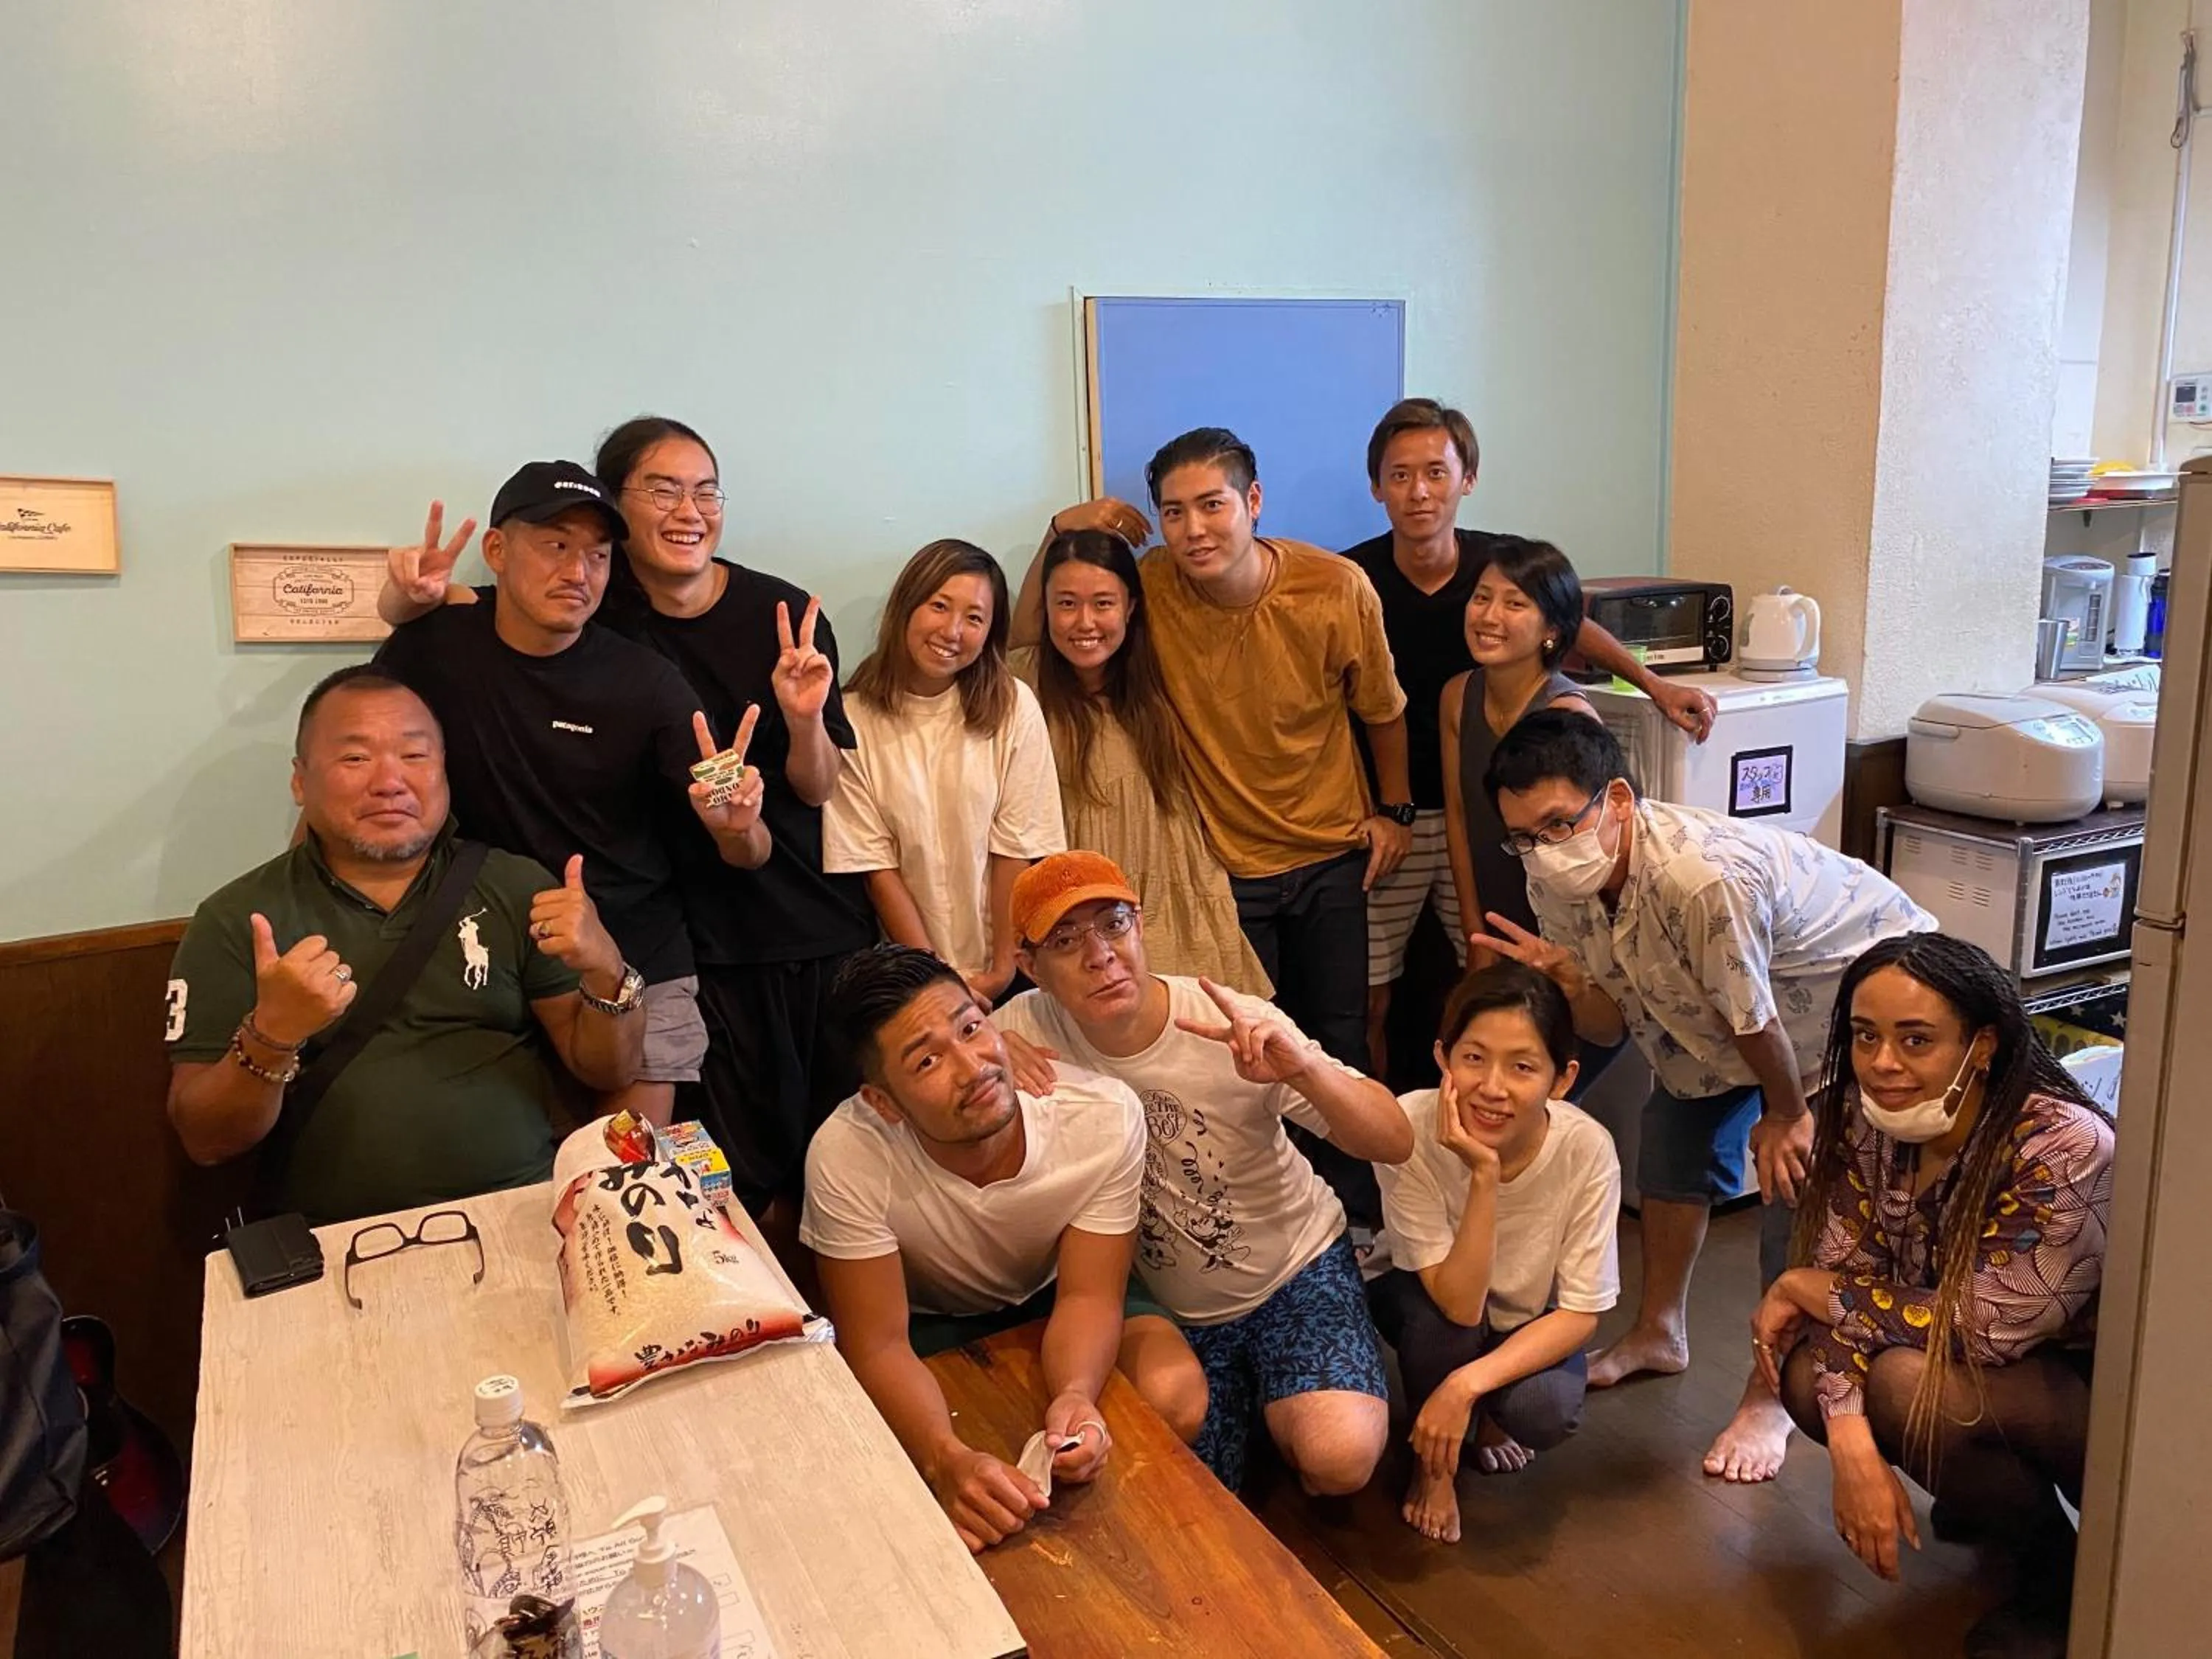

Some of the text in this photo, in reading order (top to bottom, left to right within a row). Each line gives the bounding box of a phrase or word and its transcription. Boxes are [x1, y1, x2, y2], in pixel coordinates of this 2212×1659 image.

[0, 521, 46, 534] alifornia
[282, 583, 343, 597] California
[552, 720, 593, 734] patagonia
[164, 978, 188, 1040] 3
